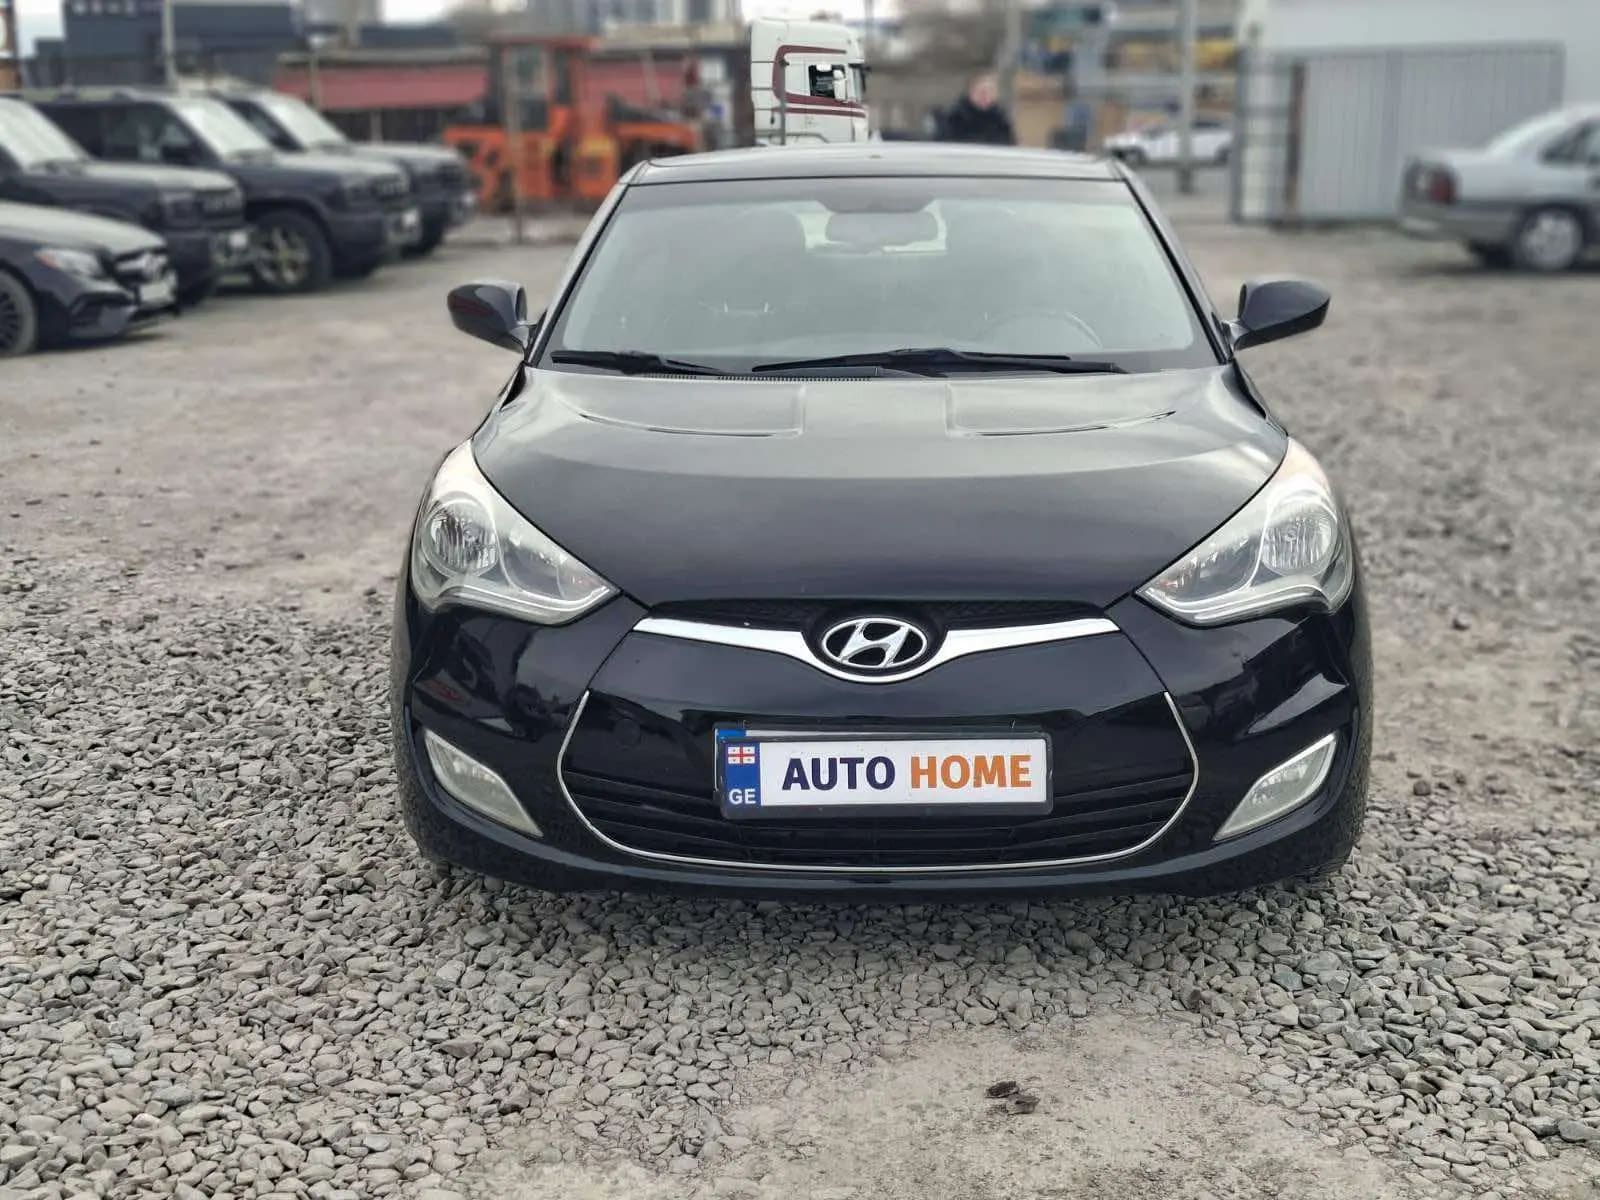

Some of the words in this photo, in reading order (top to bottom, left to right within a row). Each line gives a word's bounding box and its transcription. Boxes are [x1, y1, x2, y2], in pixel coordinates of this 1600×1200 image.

[781, 756, 896, 791] AUTO
[910, 754, 1032, 789] HOME
[728, 788, 757, 805] GE
